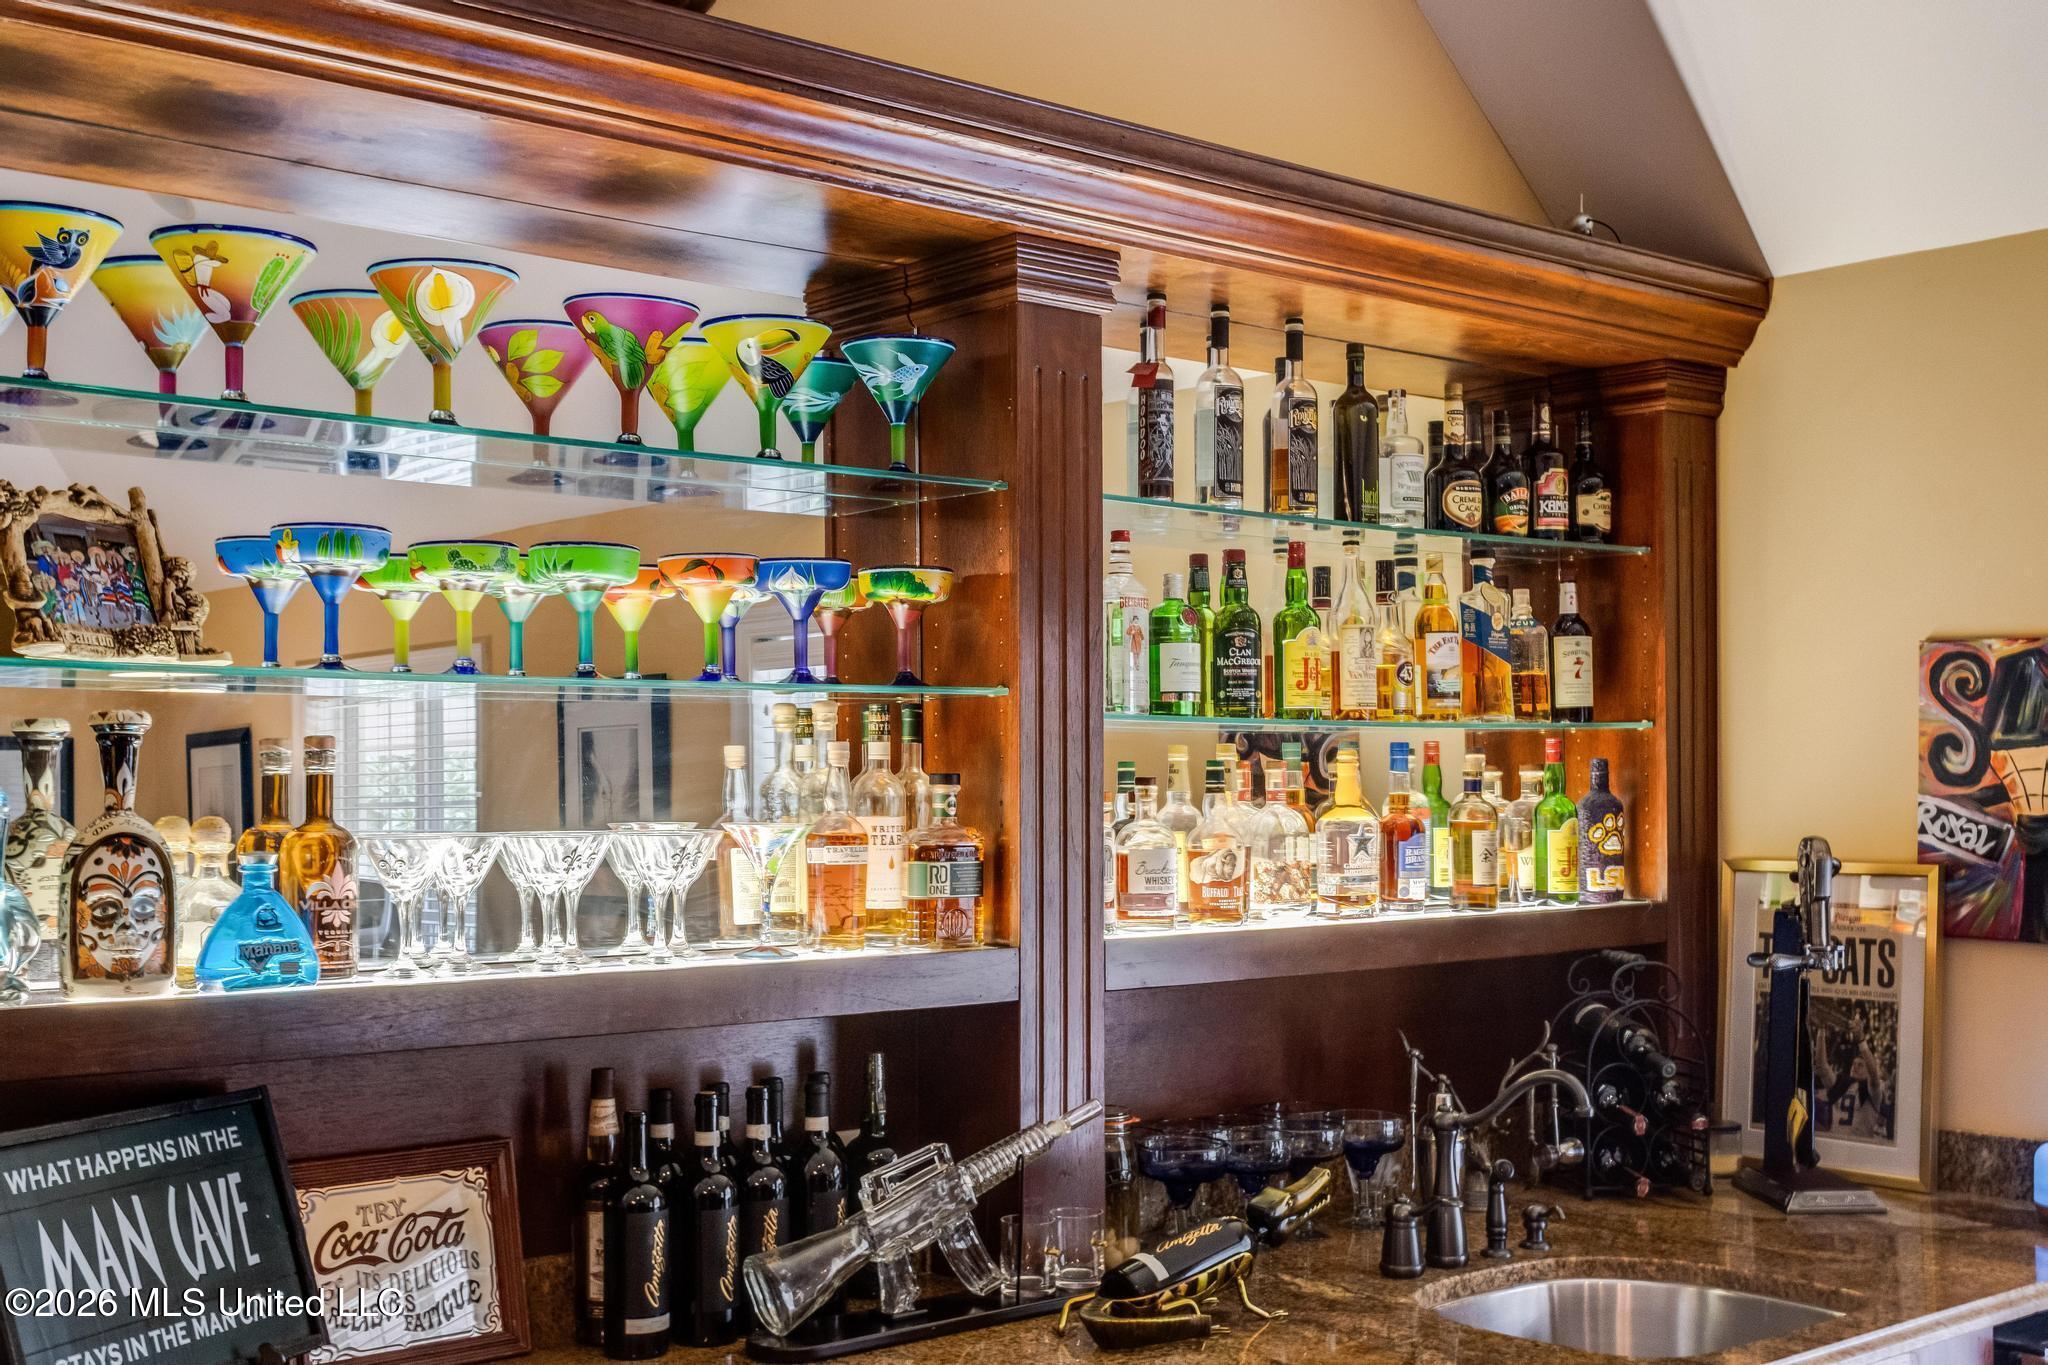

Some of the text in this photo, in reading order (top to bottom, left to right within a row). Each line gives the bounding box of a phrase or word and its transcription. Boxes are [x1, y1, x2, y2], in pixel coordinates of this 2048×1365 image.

[1539, 501, 1569, 513] KAMO
[1229, 648, 1251, 656] CLAN
[929, 865, 948, 884] RD
[929, 885, 948, 896] ONE
[4, 1126, 242, 1195] WHAT HAPPENS IN THE
[356, 1197, 407, 1228] TRY
[38, 1172, 260, 1315] MAN CAVE
[314, 1207, 469, 1276] Coca-Cola
[390, 1250, 481, 1294] DELICIOUS
[404, 1279, 482, 1333] FATIGUE
[126, 1333, 150, 1363] IN
[149, 1321, 191, 1354] THE
[193, 1308, 242, 1343] MAN
